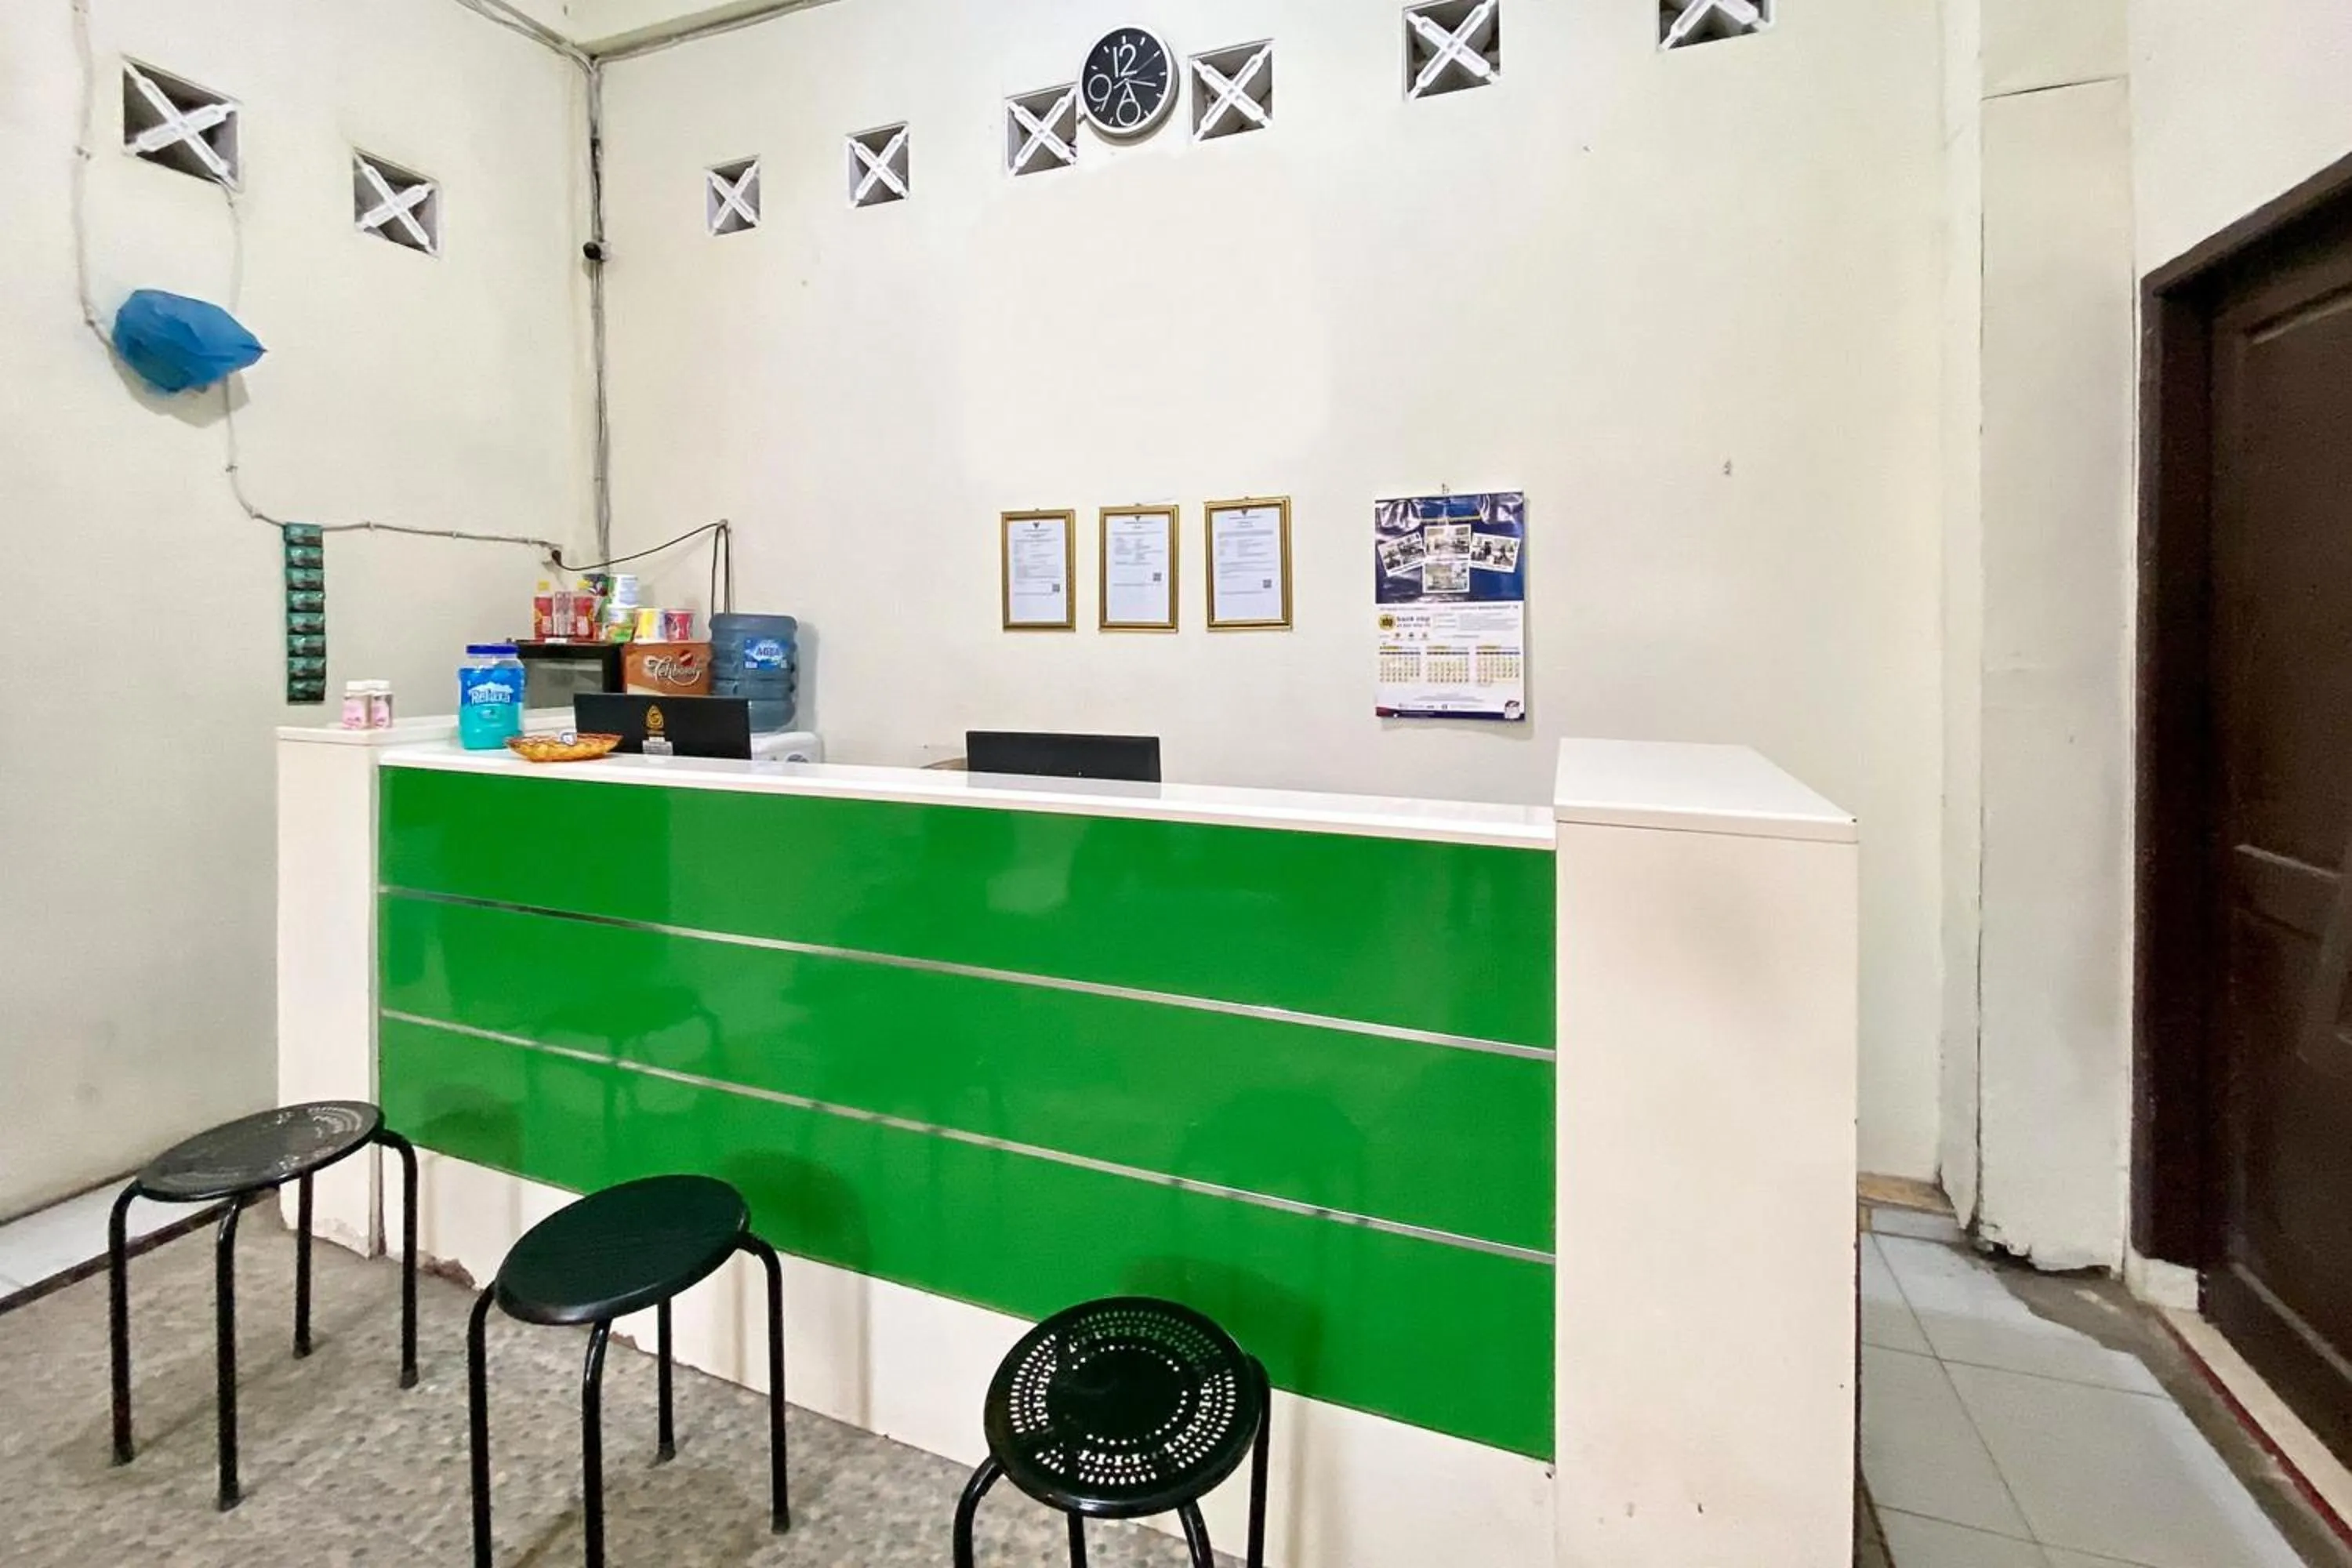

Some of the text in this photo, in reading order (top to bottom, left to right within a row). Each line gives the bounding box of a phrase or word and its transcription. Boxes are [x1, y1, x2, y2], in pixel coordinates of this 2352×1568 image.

[1112, 44, 1138, 78] 12
[1087, 74, 1112, 112] 9
[1116, 82, 1142, 126] 6
[470, 690, 510, 705] Relaxa
